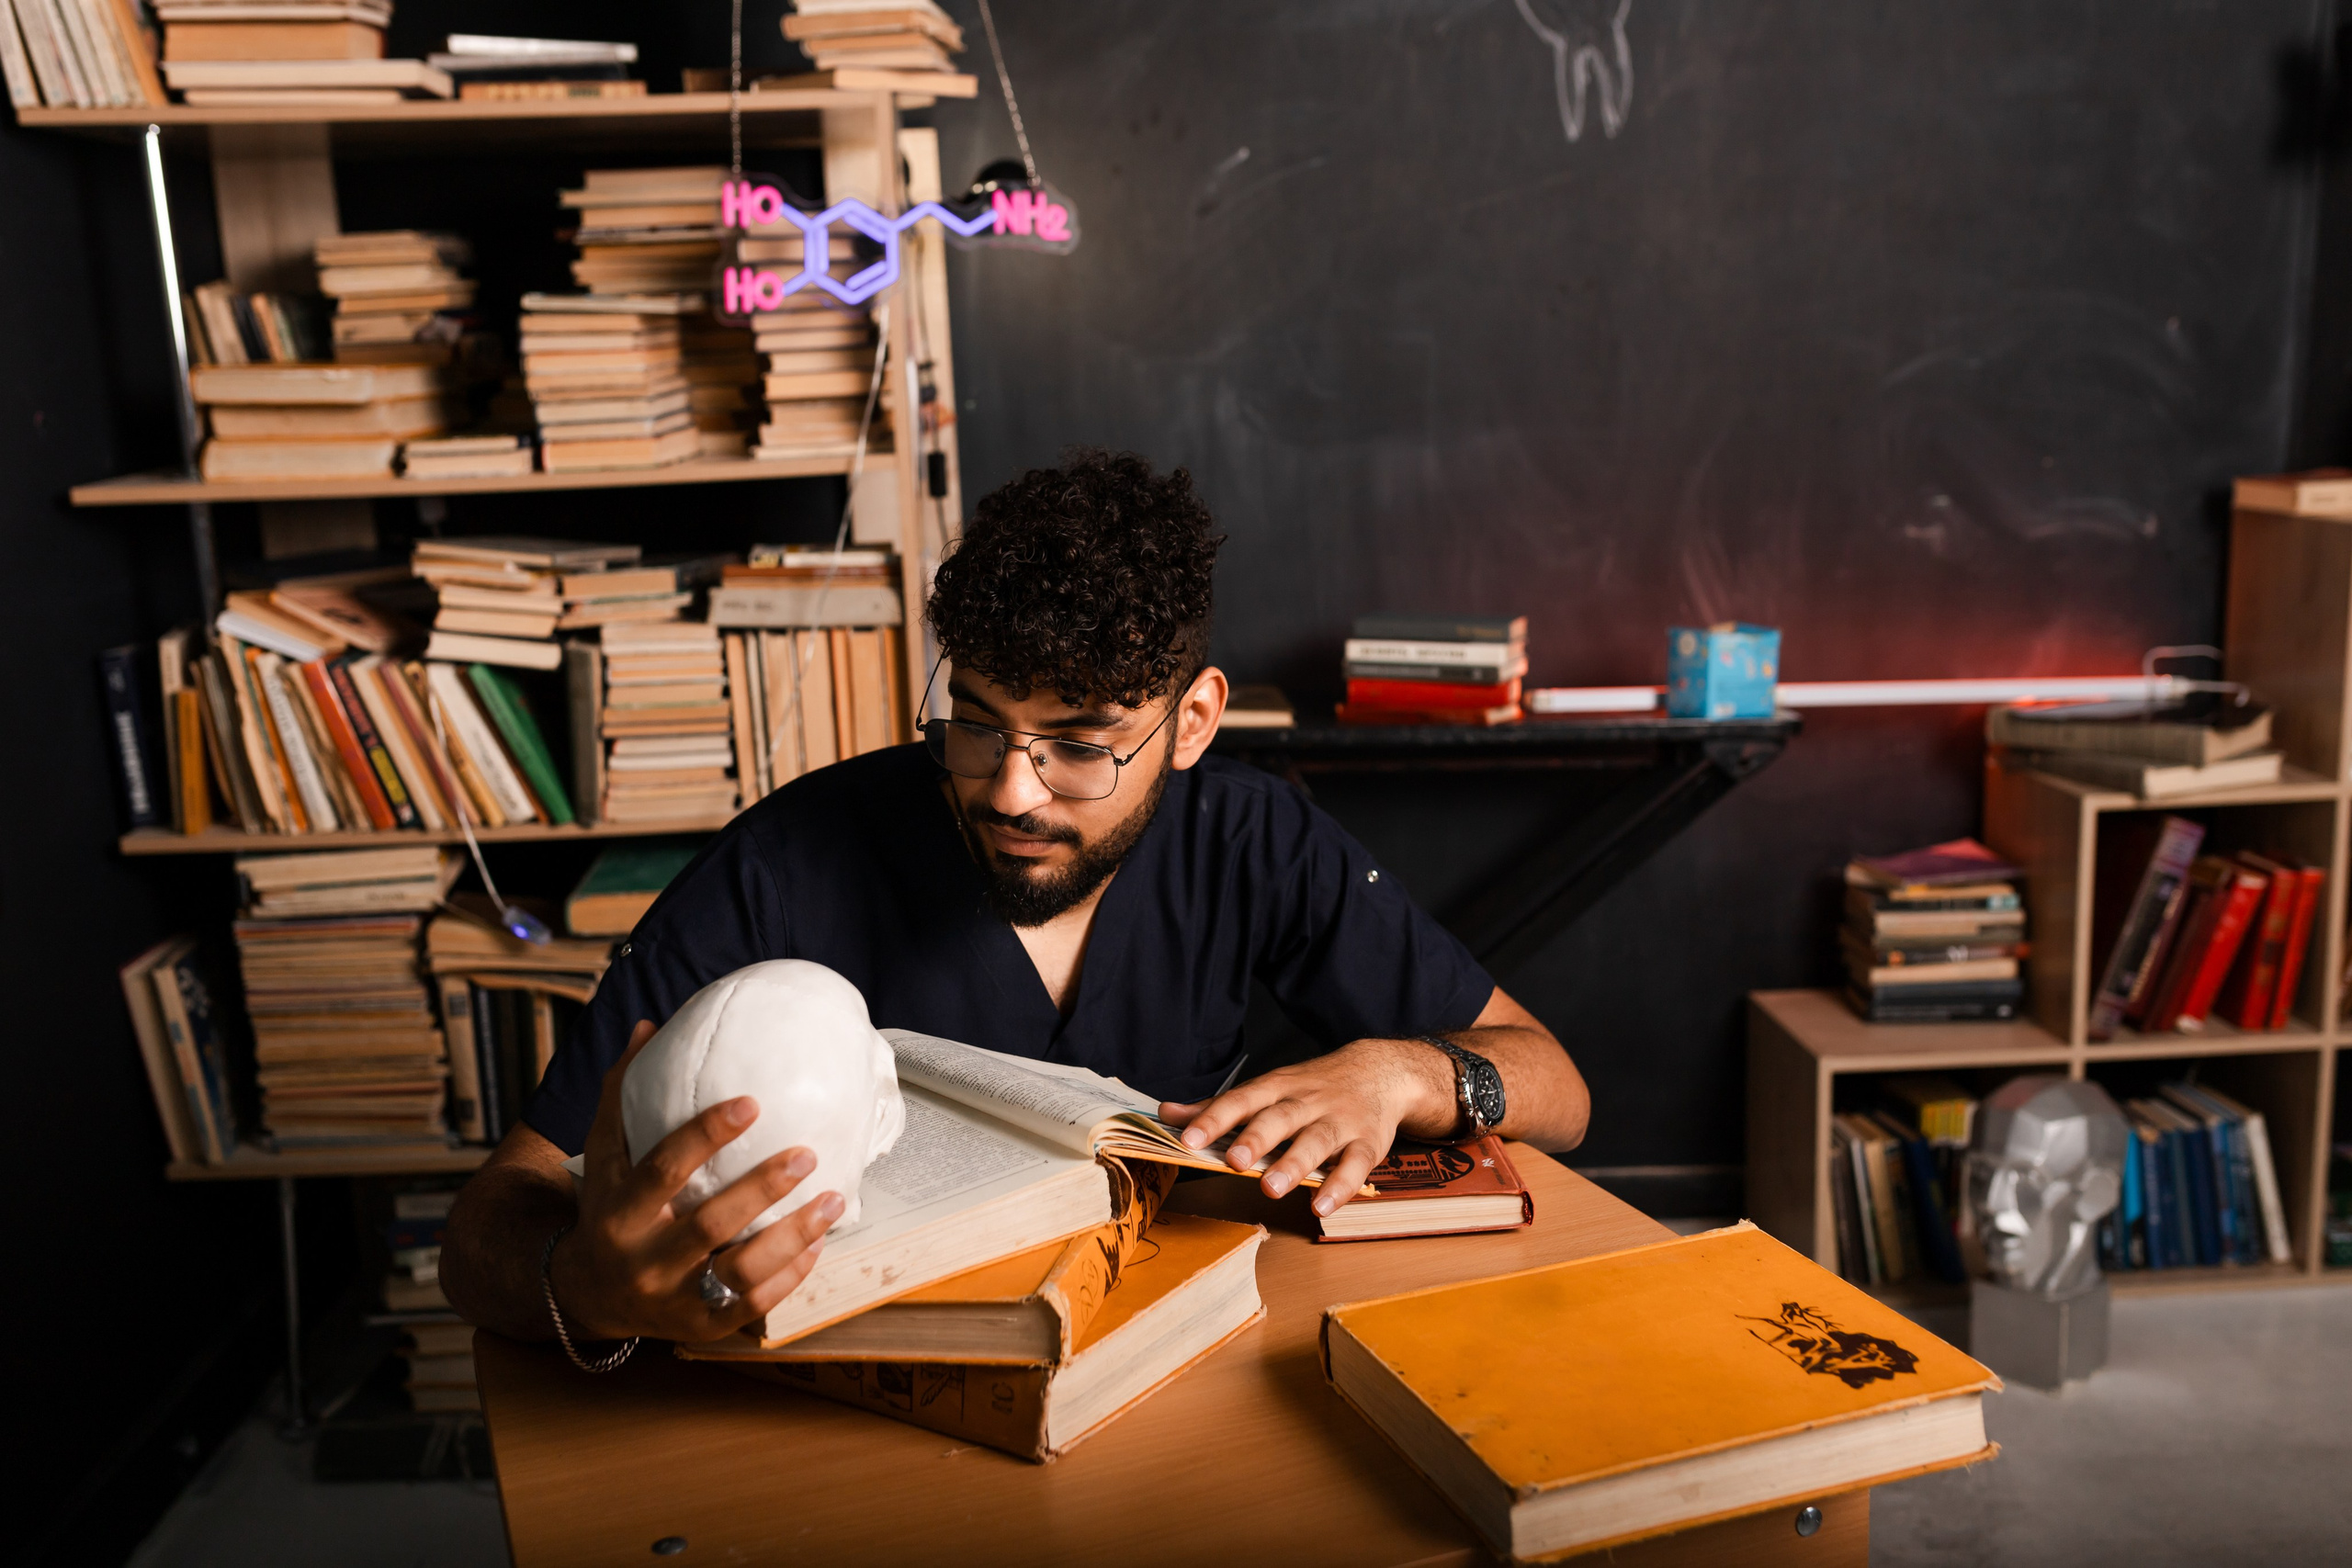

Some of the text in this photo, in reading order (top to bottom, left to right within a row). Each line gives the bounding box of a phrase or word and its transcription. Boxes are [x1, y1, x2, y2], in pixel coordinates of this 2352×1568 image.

[721, 181, 784, 229] HO
[991, 188, 1073, 242] NH2
[723, 265, 785, 313] HO
